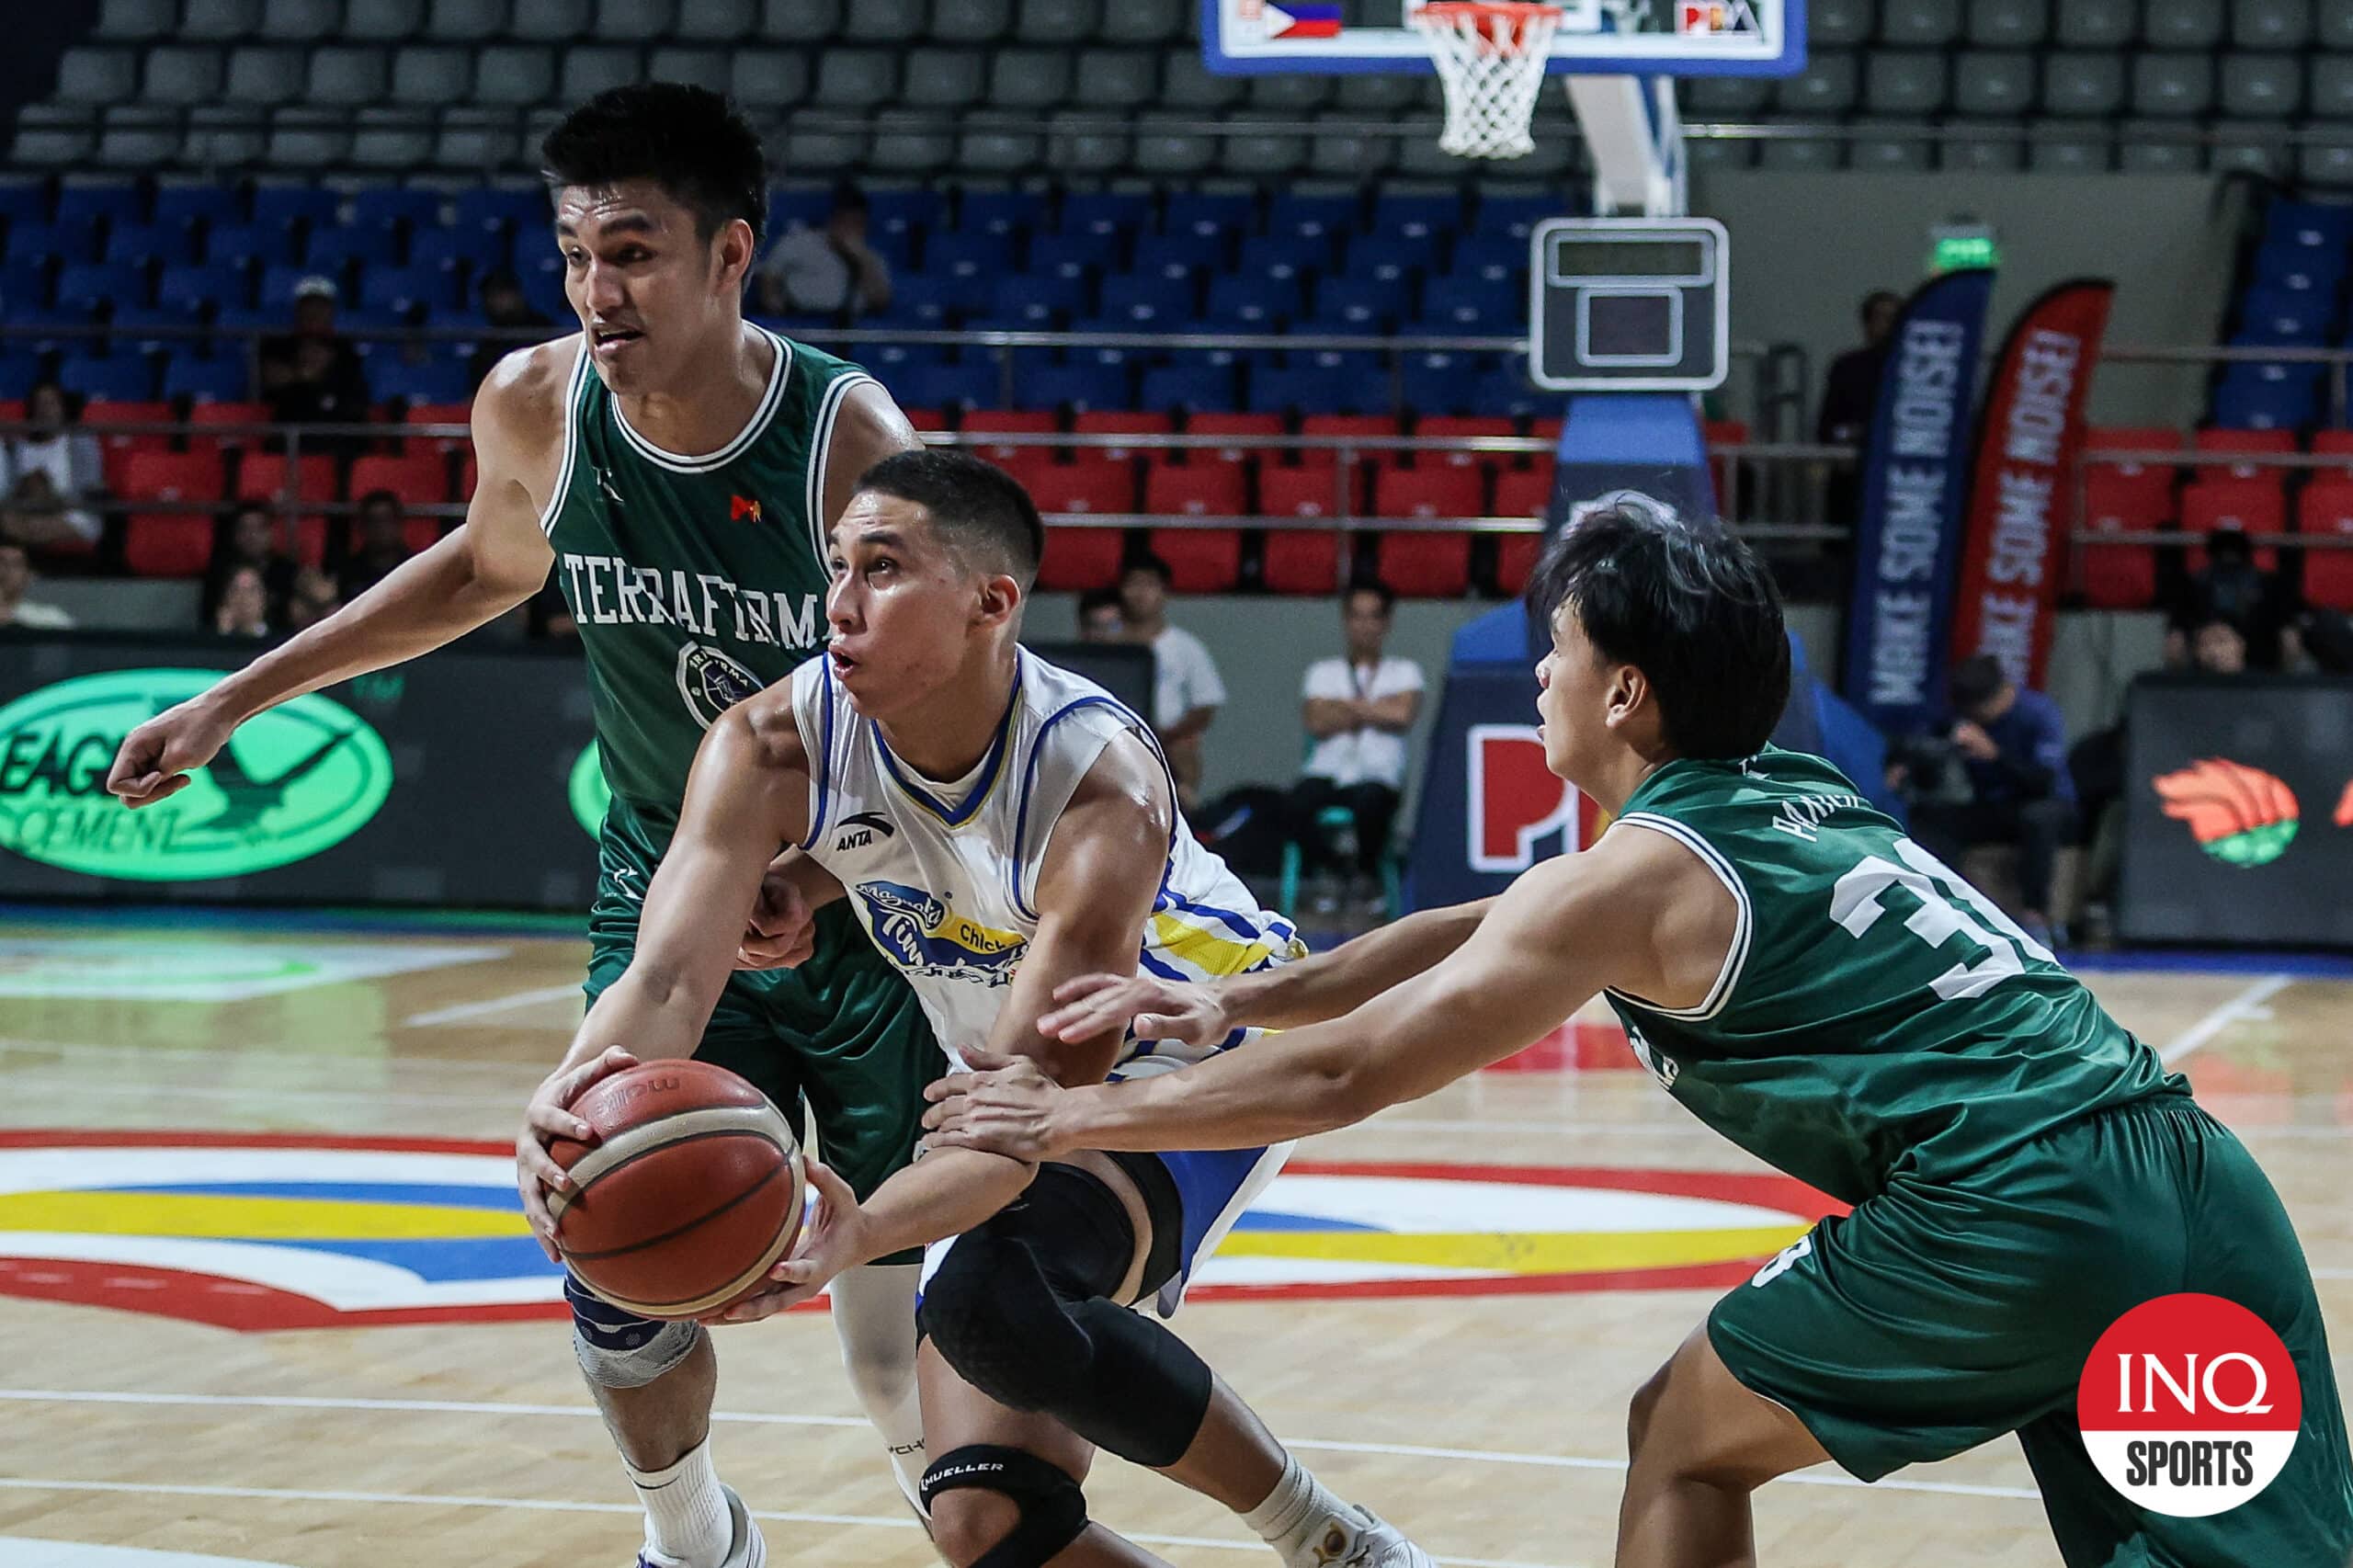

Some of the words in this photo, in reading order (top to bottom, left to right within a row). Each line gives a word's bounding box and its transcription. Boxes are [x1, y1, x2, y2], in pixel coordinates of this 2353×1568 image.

[1891, 320, 1964, 457] NOISE!
[2005, 330, 2081, 466] NOISE!
[1877, 464, 1947, 581] SOME
[1985, 470, 2055, 586] SOME
[554, 553, 833, 650] TERRAFIRM
[1868, 591, 1929, 705] MAKE
[1979, 593, 2038, 687] AKE
[836, 829, 873, 851] ANTA
[925, 1463, 1004, 1485] MUELLER
